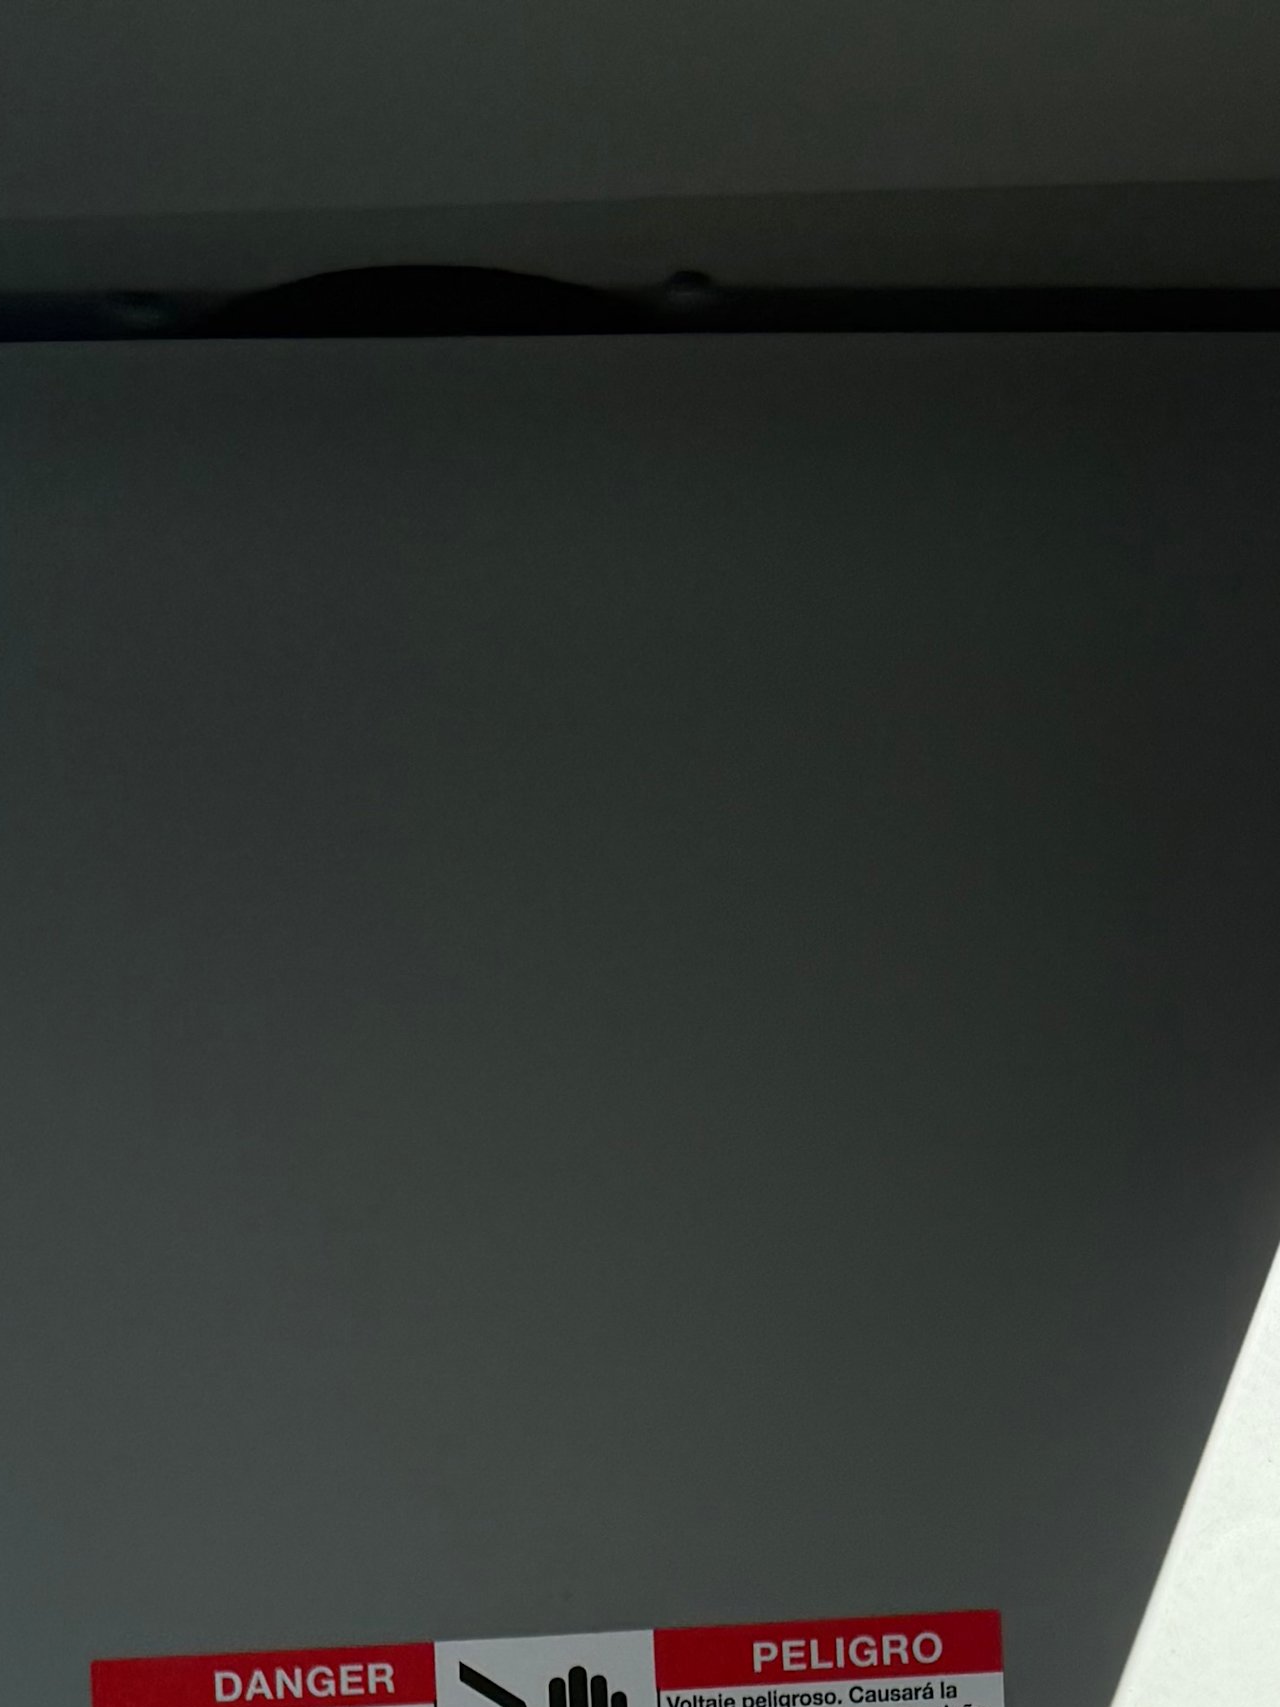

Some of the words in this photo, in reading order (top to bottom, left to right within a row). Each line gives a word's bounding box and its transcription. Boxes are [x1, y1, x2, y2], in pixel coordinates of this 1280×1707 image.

[752, 1631, 942, 1672] PELIGRO
[214, 1663, 394, 1701] DANGER
[848, 1682, 933, 1703] Causará
[940, 1681, 957, 1698] la
